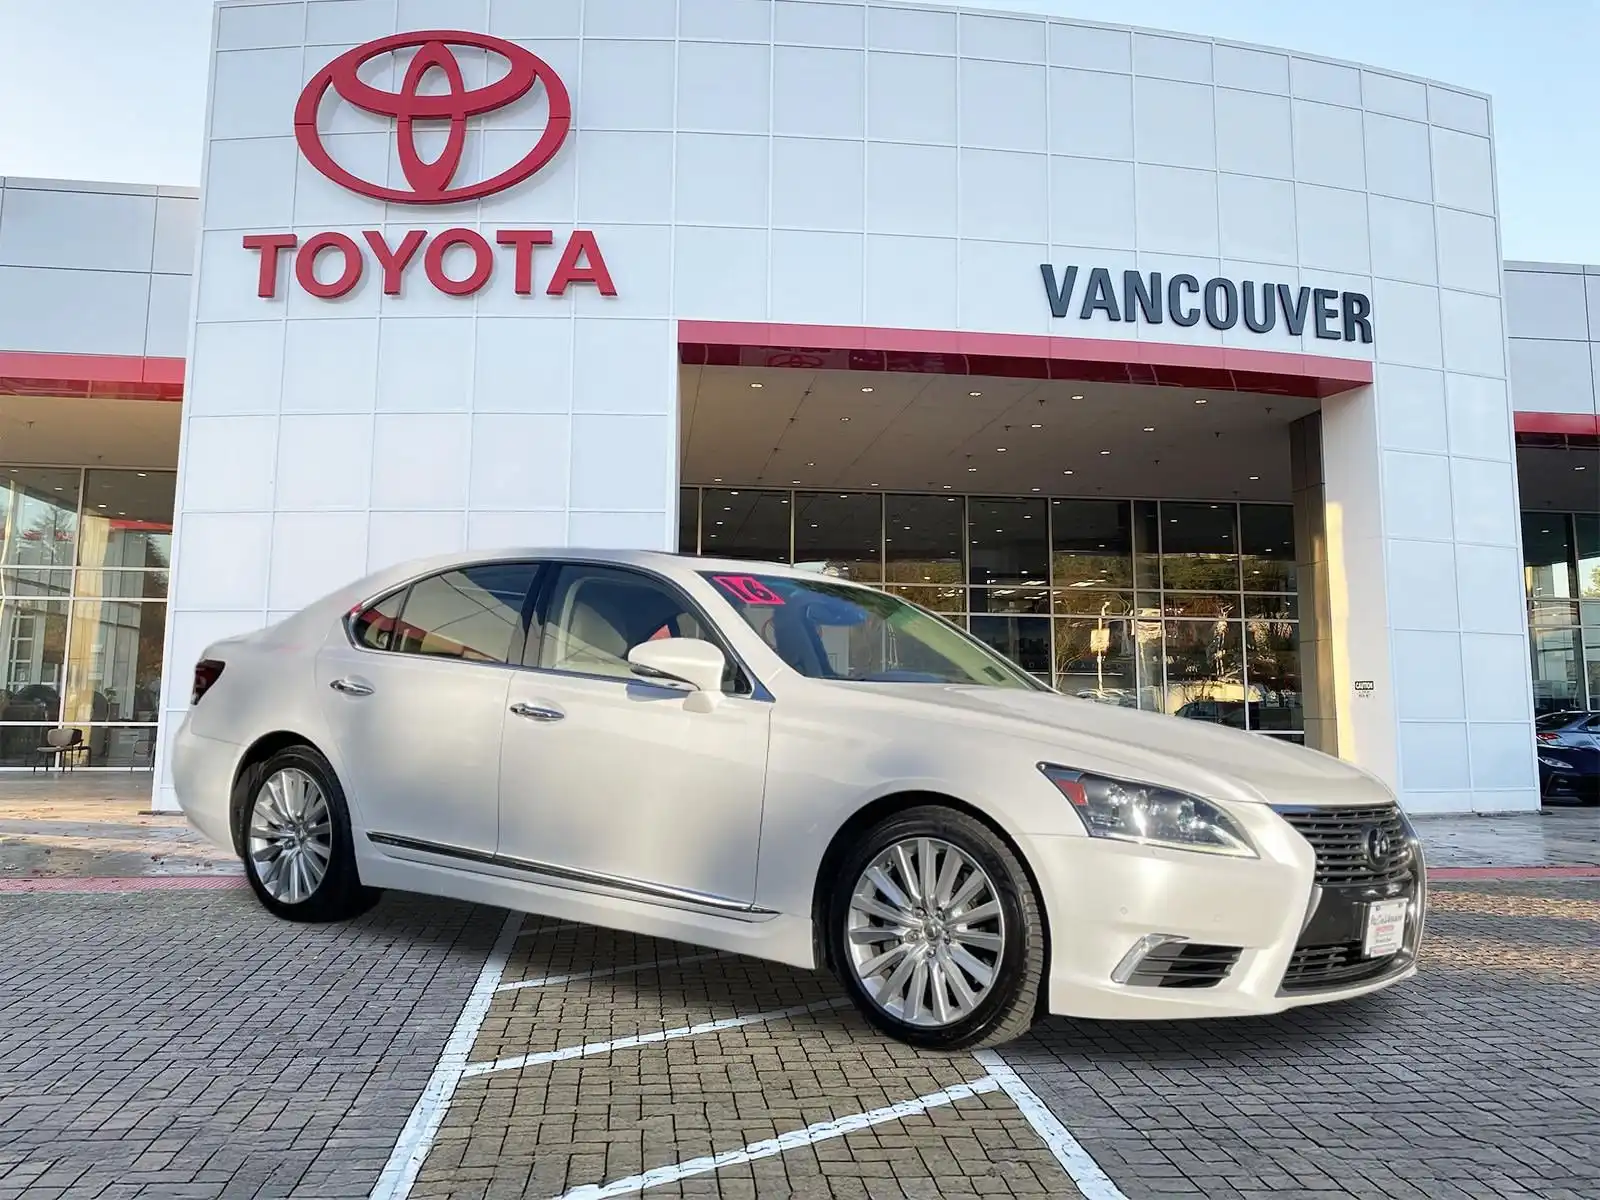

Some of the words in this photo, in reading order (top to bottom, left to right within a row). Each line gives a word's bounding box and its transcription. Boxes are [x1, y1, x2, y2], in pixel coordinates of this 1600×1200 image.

[243, 228, 617, 299] TOYOTA
[1040, 264, 1373, 343] VANCOUVER
[719, 578, 773, 601] 16
